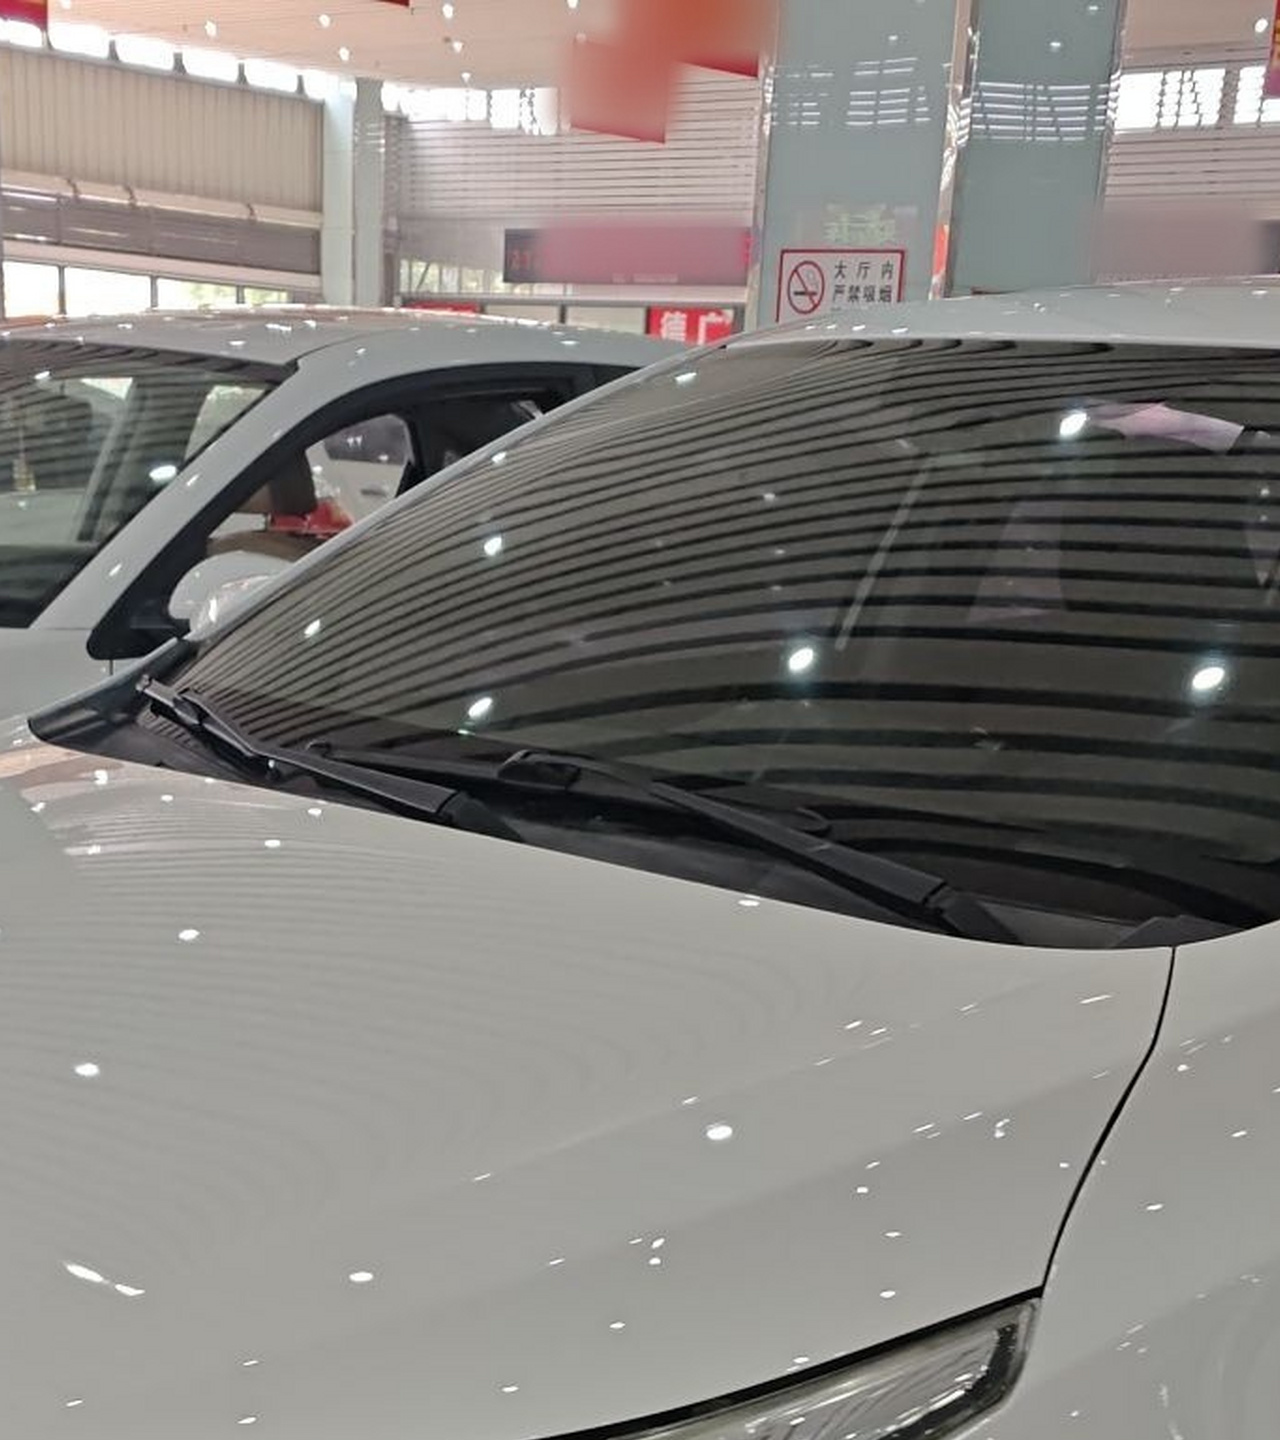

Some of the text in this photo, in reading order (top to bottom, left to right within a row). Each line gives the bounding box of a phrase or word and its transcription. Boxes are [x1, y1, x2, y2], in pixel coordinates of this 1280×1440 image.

[833, 260, 894, 280] 大厅内
[831, 284, 892, 303] 严禁吸烟
